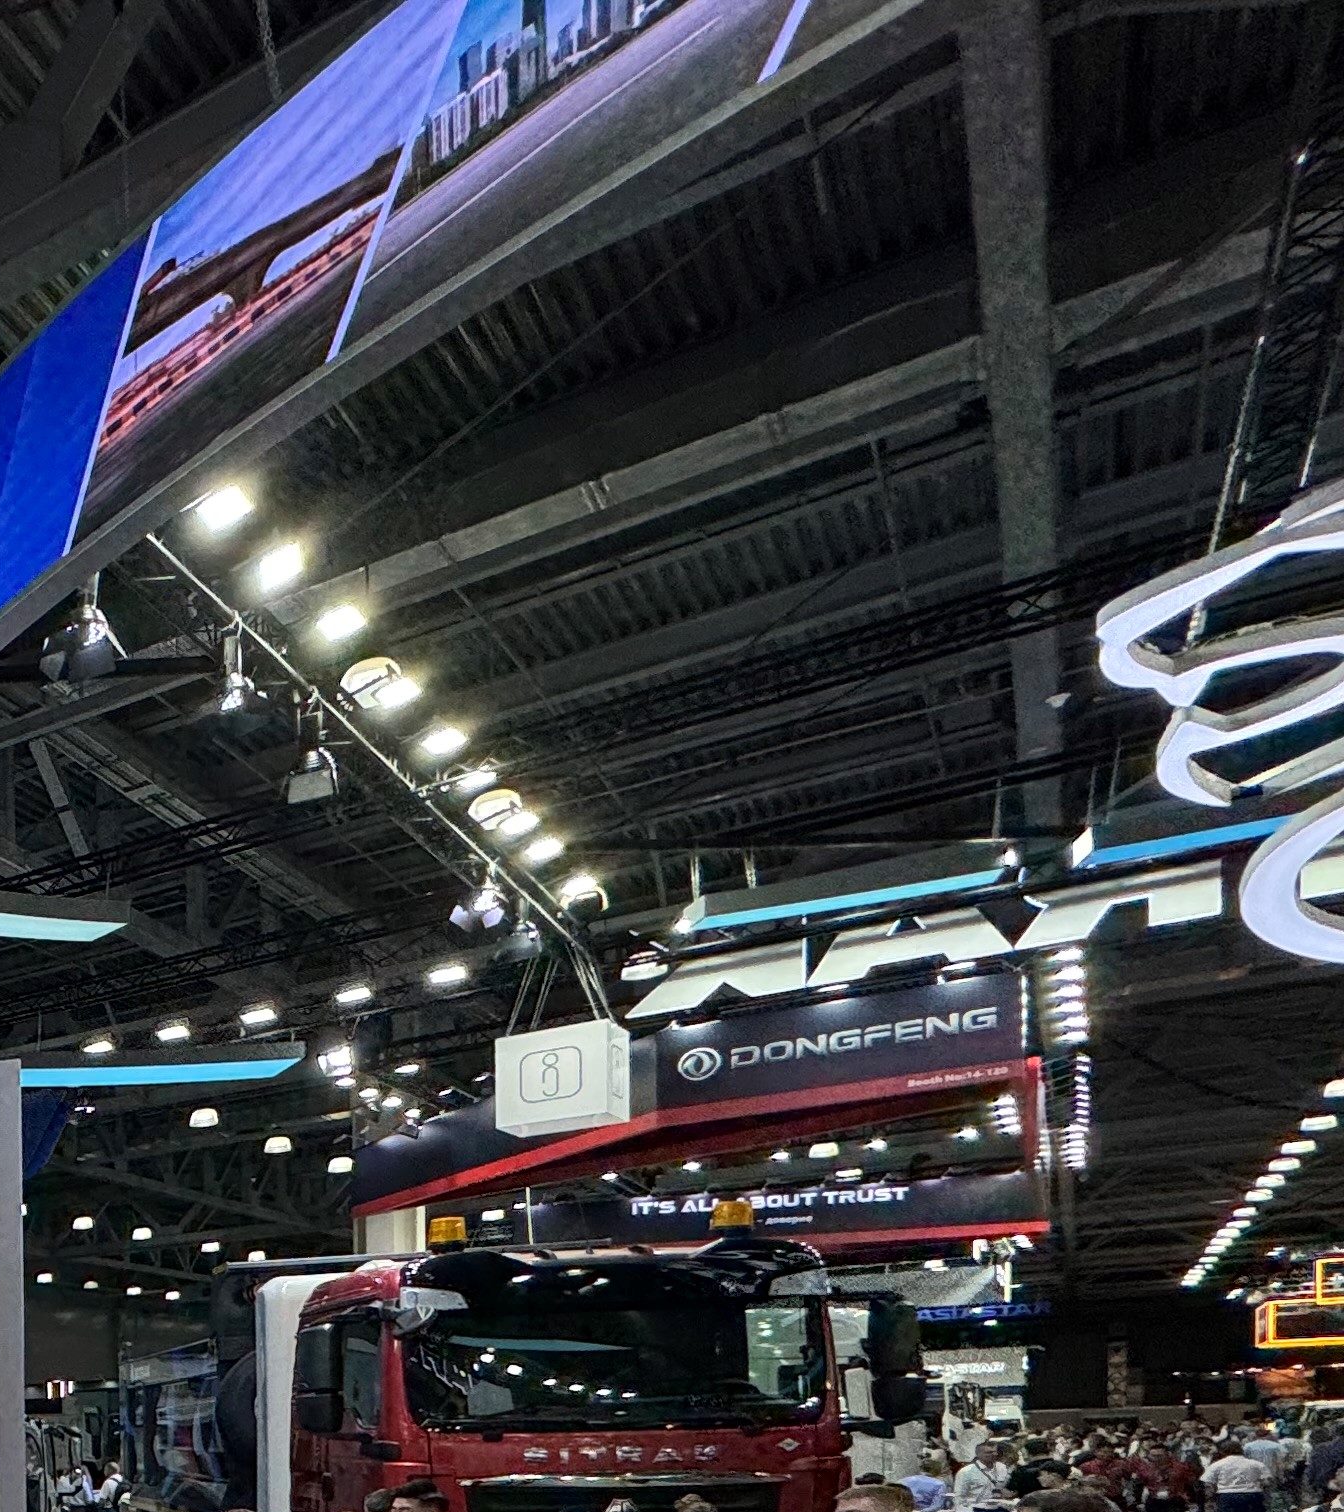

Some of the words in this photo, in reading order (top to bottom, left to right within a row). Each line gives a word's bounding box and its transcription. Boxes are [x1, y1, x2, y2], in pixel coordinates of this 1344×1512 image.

[730, 1006, 998, 1069] DONGFENG
[631, 1200, 675, 1215] IT'S
[822, 1187, 909, 1205] TRUST
[522, 1444, 717, 1464] SITRAK
